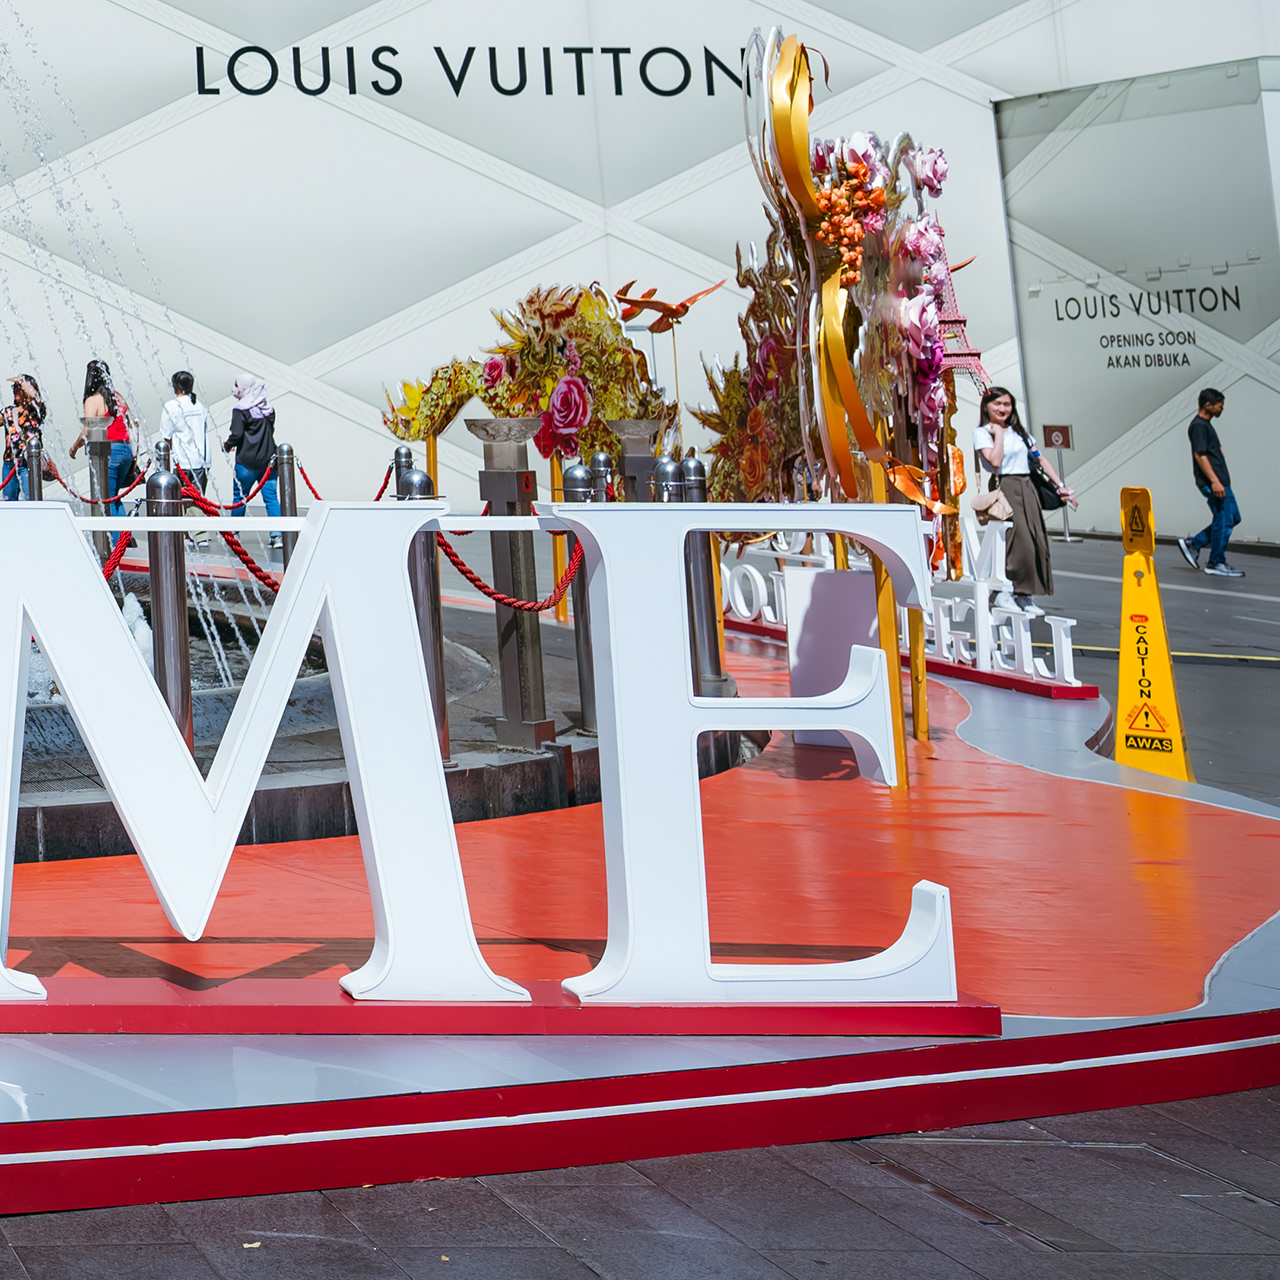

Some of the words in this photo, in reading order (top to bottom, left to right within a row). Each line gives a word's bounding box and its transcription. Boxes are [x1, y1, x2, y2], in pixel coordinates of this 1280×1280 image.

[196, 45, 405, 97] LOUIS
[432, 45, 753, 99] VUITTON
[1055, 294, 1120, 321] LOUIS
[1129, 285, 1241, 316] VUITTON
[1099, 333, 1155, 349] OPENING
[1158, 331, 1197, 346] SOON
[1107, 354, 1141, 369] AKAN
[1144, 352, 1191, 368] DIBUKA
[1135, 625, 1152, 699] CAUTION
[1126, 736, 1172, 752] AWAS
